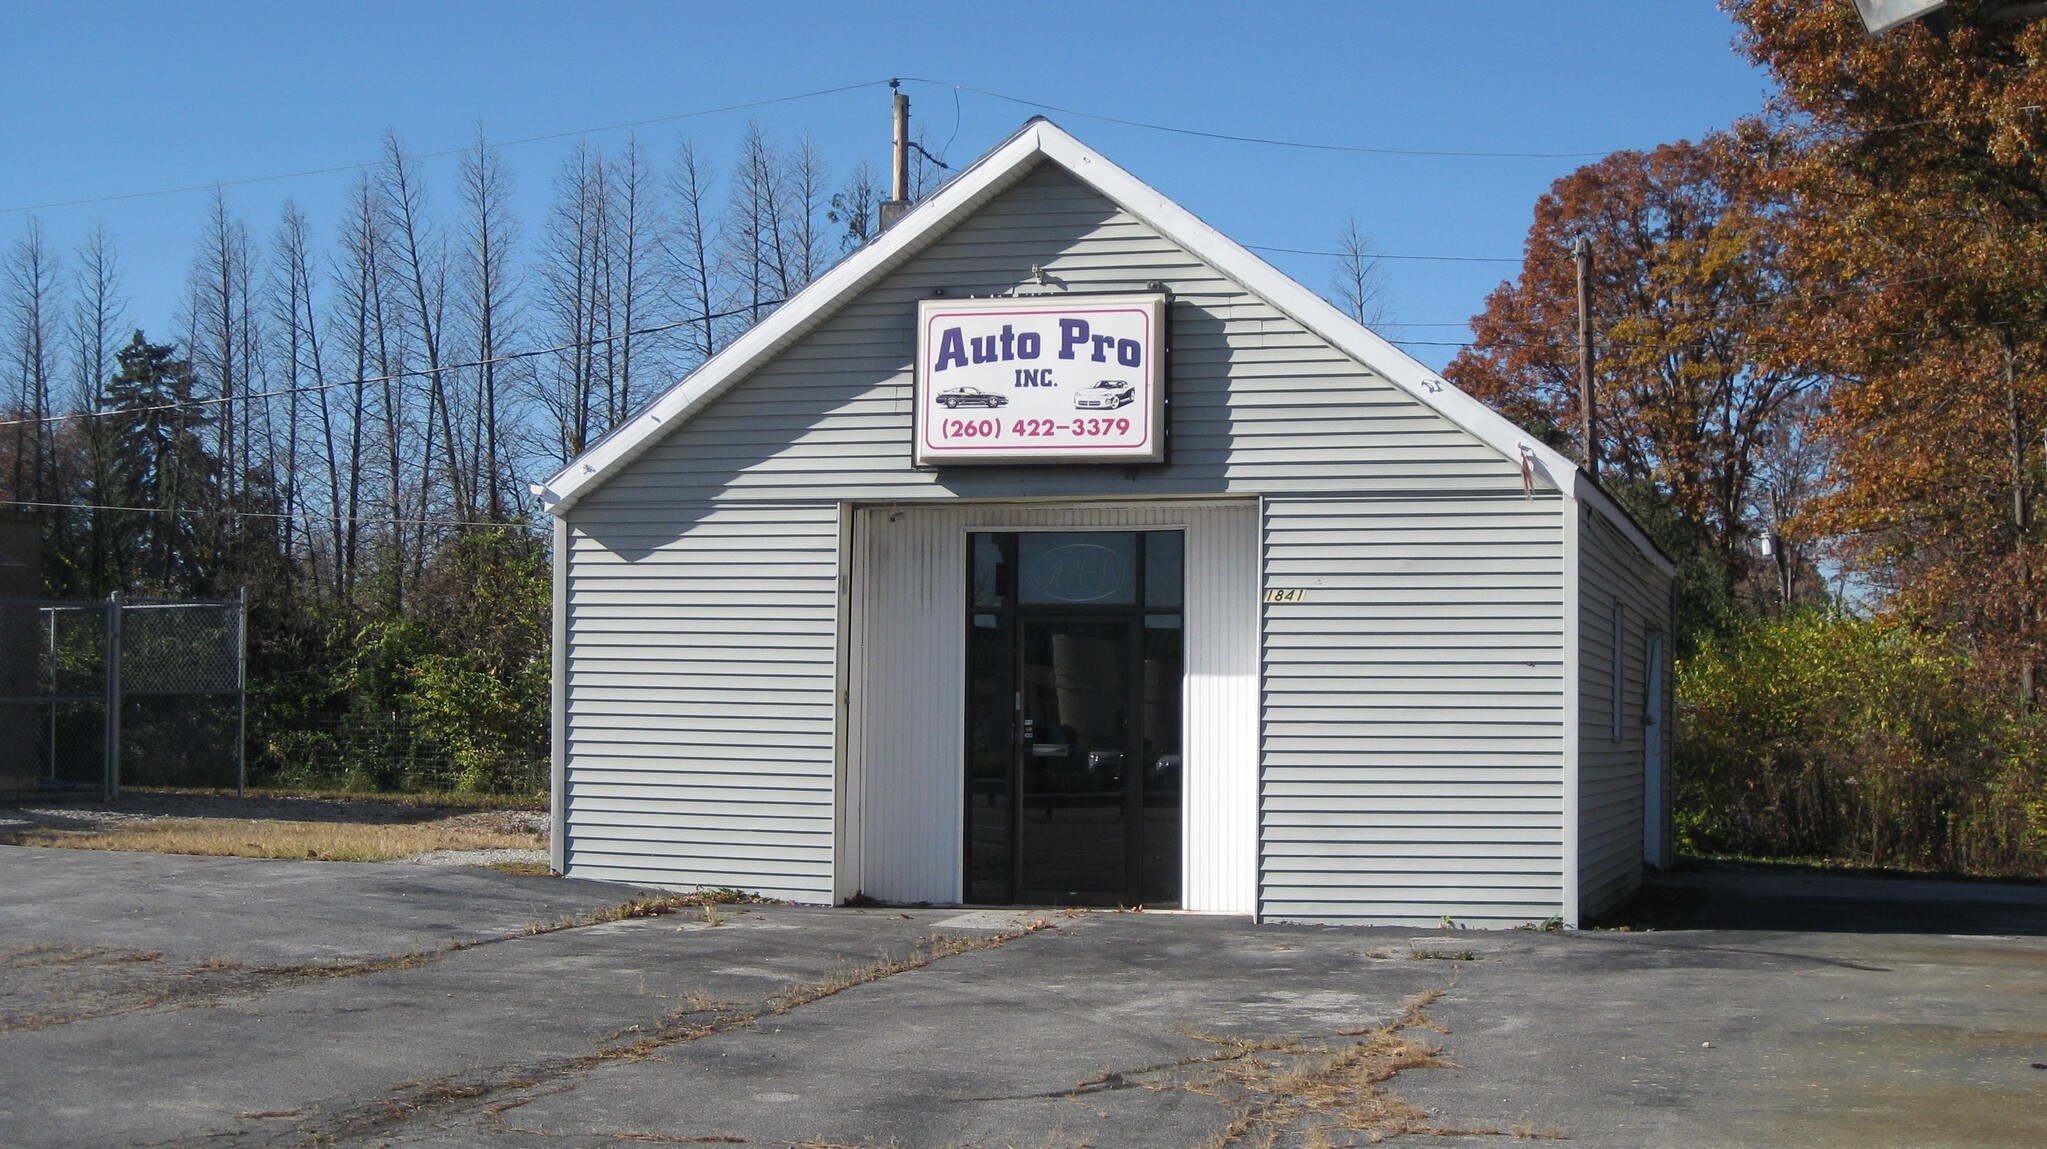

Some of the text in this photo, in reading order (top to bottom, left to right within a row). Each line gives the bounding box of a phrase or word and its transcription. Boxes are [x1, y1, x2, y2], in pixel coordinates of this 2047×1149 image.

[934, 318, 1141, 372] Auto Pro
[1014, 368, 1058, 388] INC.
[942, 417, 1130, 440] (260) 422-3379
[1030, 552, 1129, 589] OPEN
[1266, 589, 1304, 602] 1841
